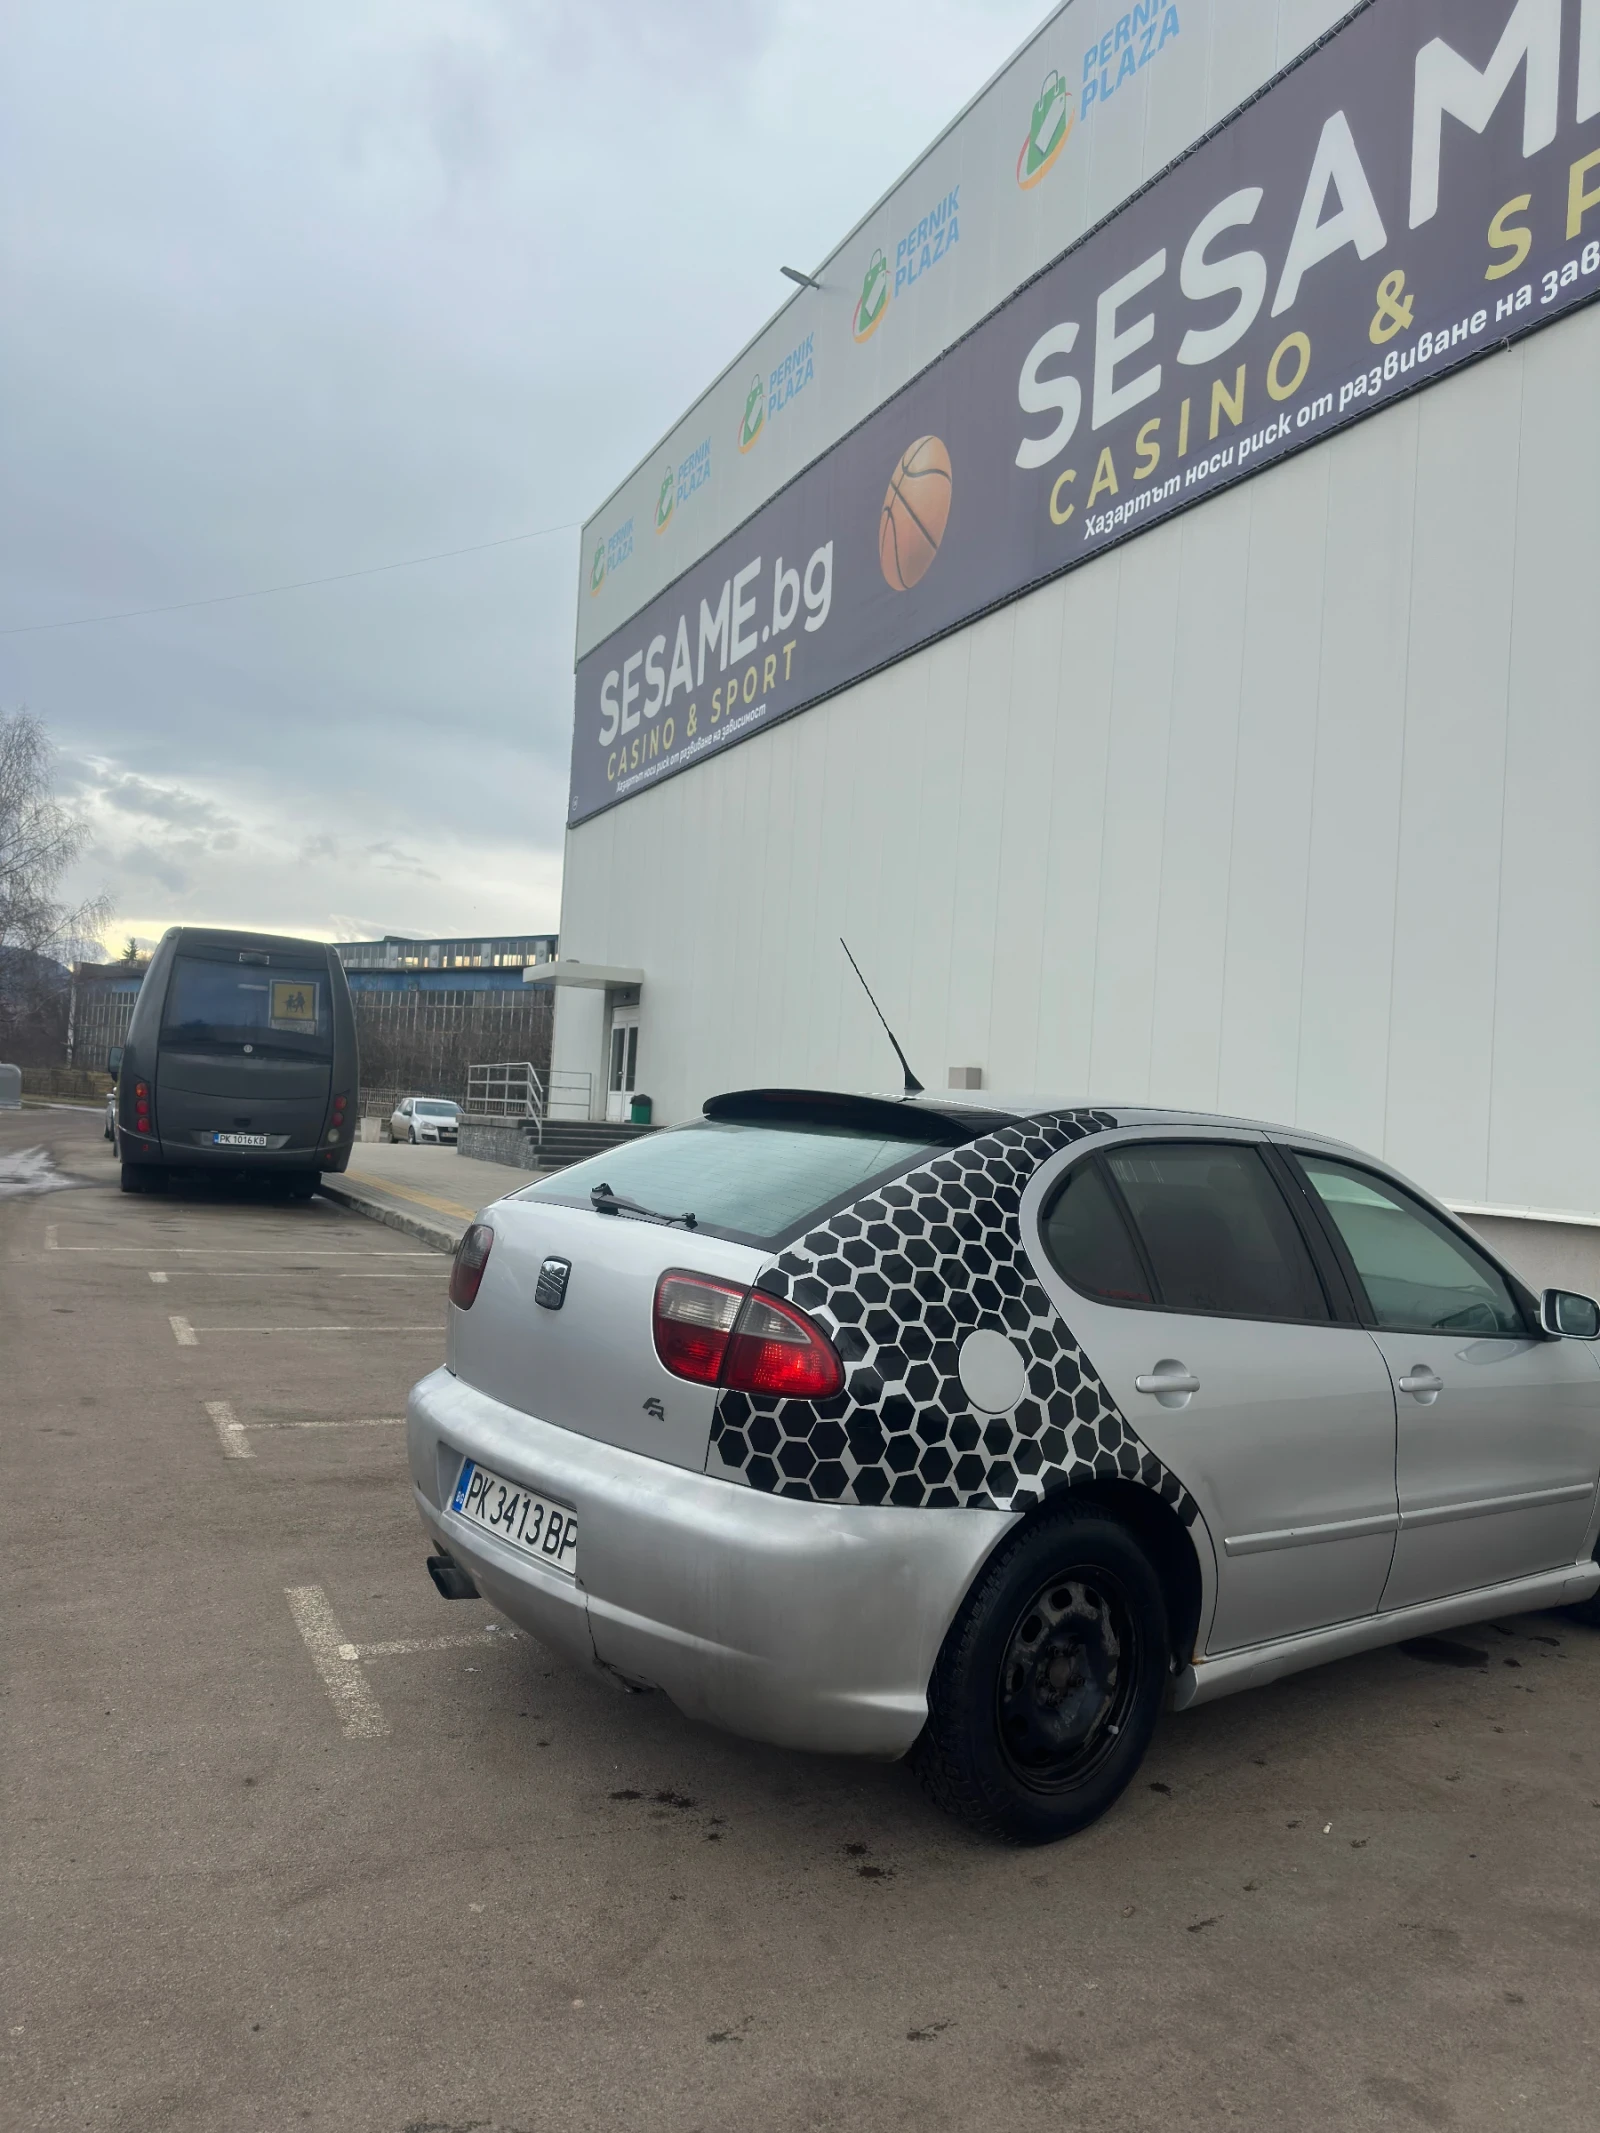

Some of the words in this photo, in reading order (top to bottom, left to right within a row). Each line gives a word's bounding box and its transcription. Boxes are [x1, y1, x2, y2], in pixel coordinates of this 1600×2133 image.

[1081, 4, 1180, 122] PLAZA
[894, 216, 960, 298] PLAZA
[896, 184, 960, 268] PERNIK
[1015, 0, 1600, 469] SESAM
[768, 358, 814, 421] PLAZA
[769, 331, 814, 395] PERNIK
[1049, 331, 1311, 526] CASINO
[1369, 269, 1414, 345] &
[1084, 475, 1181, 540] Хазартът
[1185, 445, 1234, 487] носи
[1238, 413, 1292, 465] риск
[1296, 393, 1333, 427] от
[1339, 309, 1487, 412] развиване
[1495, 284, 1532, 322] на
[676, 457, 711, 509] PLAZA
[678, 436, 711, 482] PERNIK
[607, 535, 633, 576] PLAZA
[599, 540, 834, 747] SESAME.bg
[607, 718, 675, 781] CASINO
[687, 703, 698, 737] &
[711, 640, 797, 723] SPORT
[721, 703, 766, 741] зависимост
